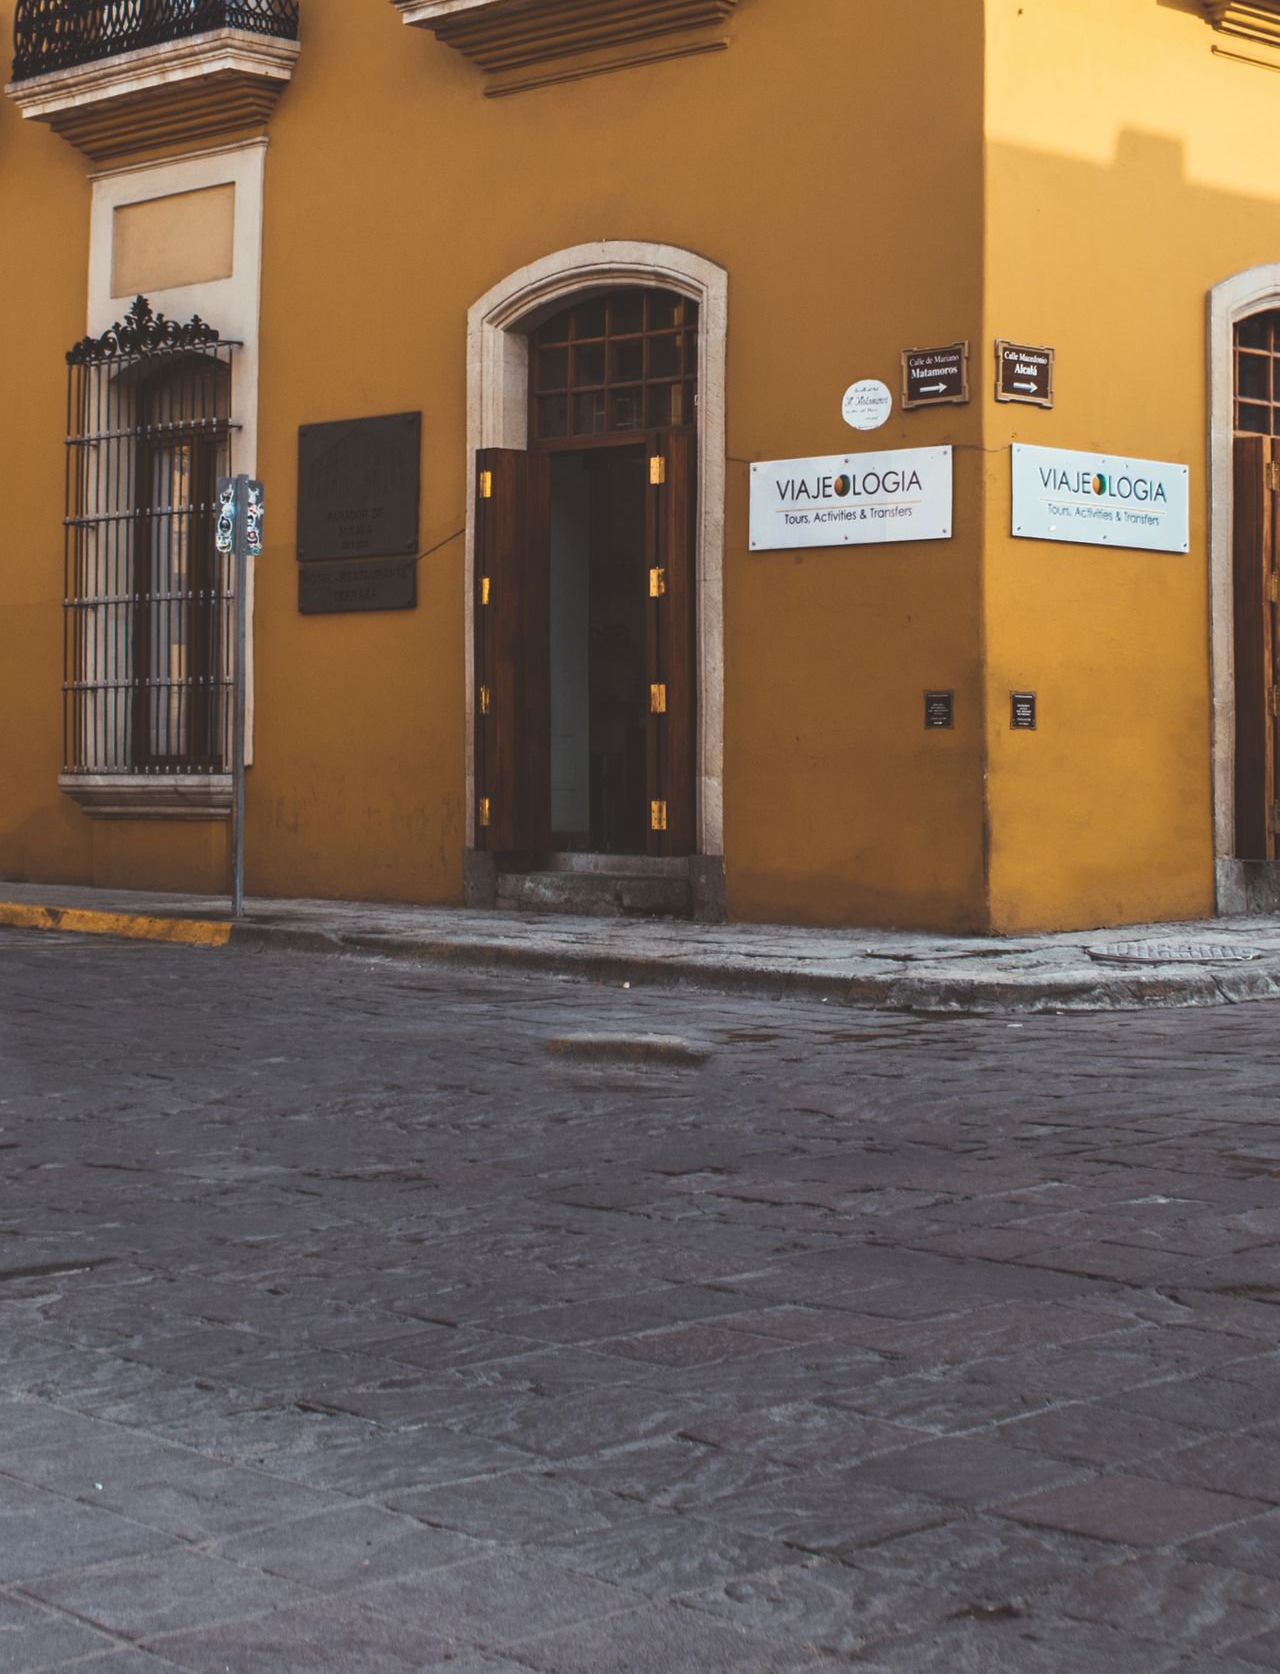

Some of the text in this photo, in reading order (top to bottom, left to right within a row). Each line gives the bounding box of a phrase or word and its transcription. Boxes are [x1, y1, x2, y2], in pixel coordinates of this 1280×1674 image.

[909, 355, 960, 366] Calle de Mariano
[1004, 351, 1048, 365] Calle Macedonio
[911, 366, 958, 379] Matamoros
[1014, 363, 1038, 376] Alcalá
[813, 509, 857, 523] Activities
[859, 508, 867, 519] &
[870, 505, 912, 519] Transfers
[1074, 508, 1113, 521] Activities
[1115, 512, 1122, 522] &
[1123, 511, 1160, 526] Transfers
